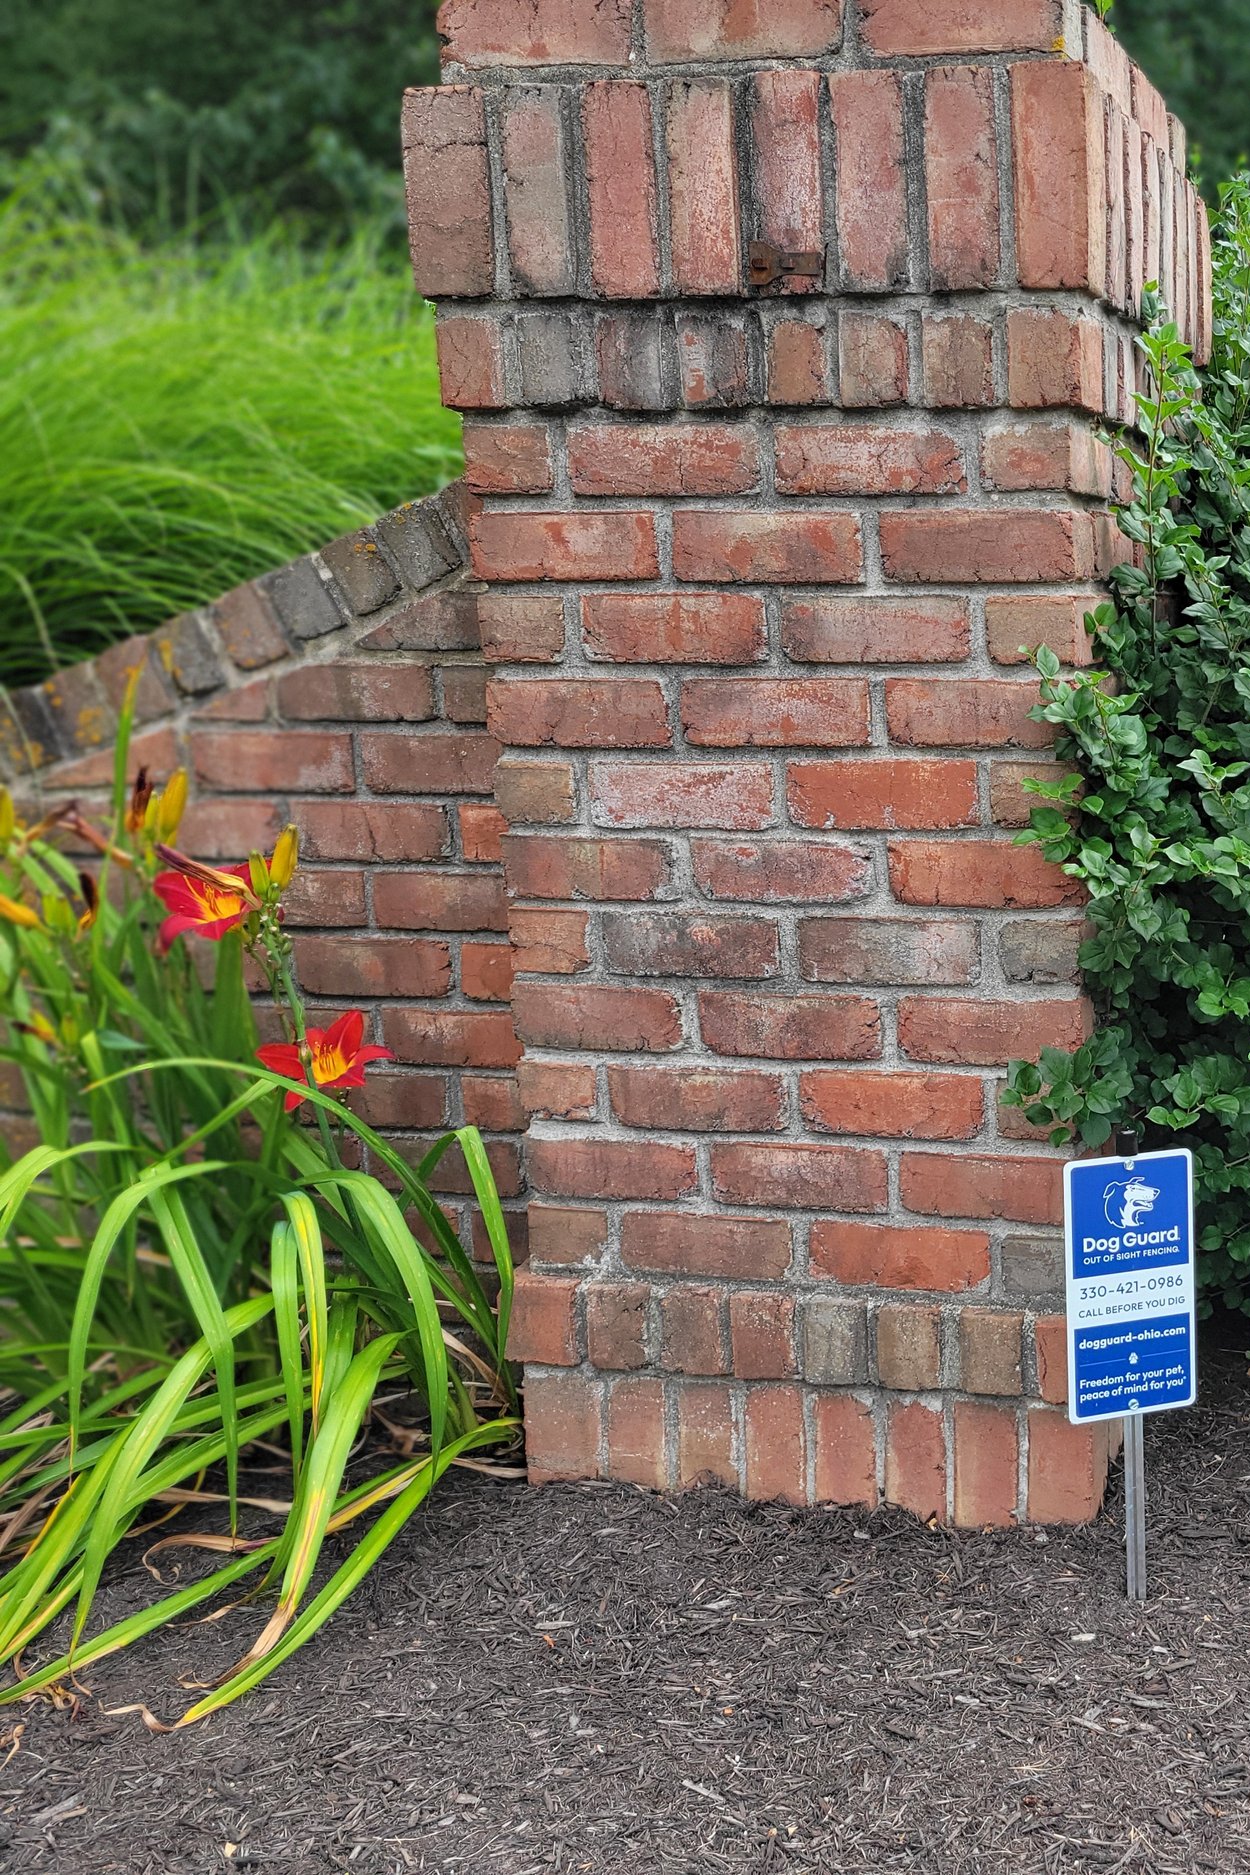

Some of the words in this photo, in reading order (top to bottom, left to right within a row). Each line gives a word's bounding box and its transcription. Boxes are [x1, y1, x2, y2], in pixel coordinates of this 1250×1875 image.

[1083, 1236, 1119, 1253] Dog
[1083, 1256, 1101, 1265] OUT
[1103, 1254, 1115, 1262] OF
[1116, 1251, 1141, 1261] SIGHT
[1080, 1275, 1183, 1300] 330-421-0986
[1078, 1307, 1103, 1318] CALL
[1105, 1302, 1143, 1314] BEFORE
[1145, 1299, 1165, 1309] YOU
[1168, 1296, 1185, 1306] DIG
[1079, 1326, 1186, 1349] dogguard-ohio.com
[1080, 1375, 1124, 1389] Freedom
[1126, 1372, 1140, 1382] for
[1142, 1369, 1164, 1381] your
[1166, 1364, 1184, 1378] pet,
[1080, 1389, 1110, 1403] peace
[1111, 1386, 1122, 1396] of
[1124, 1381, 1148, 1394] mind
[1150, 1379, 1165, 1390] for
